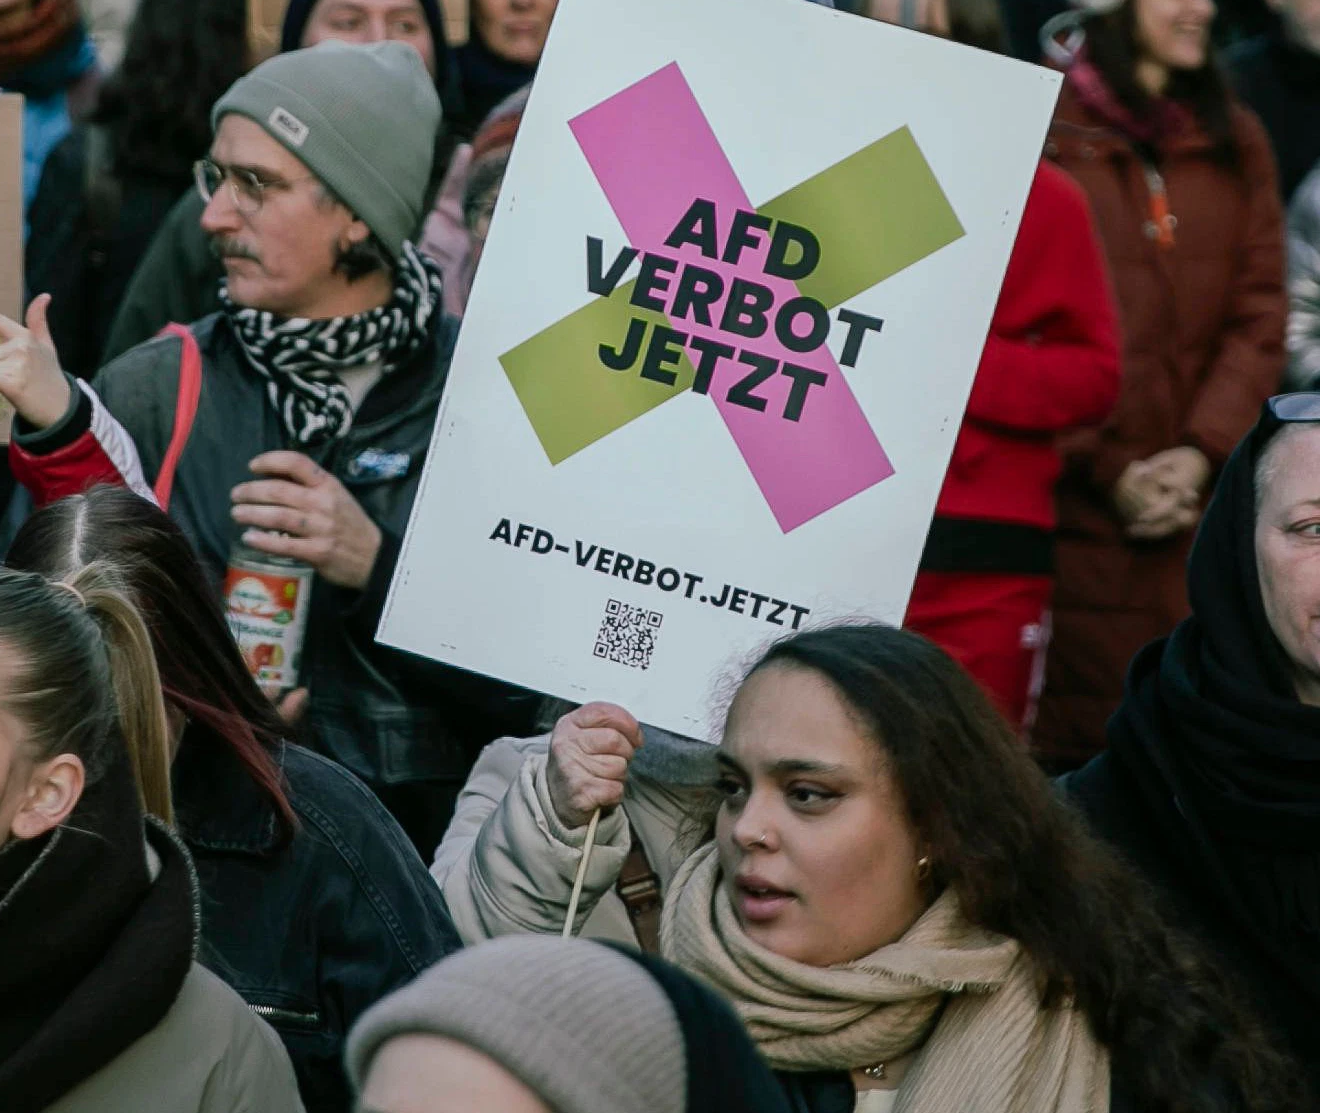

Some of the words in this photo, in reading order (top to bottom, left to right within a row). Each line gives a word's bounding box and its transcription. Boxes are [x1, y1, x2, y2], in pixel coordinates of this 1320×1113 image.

[663, 197, 822, 281] AFD
[585, 235, 885, 368] VERBOT
[597, 316, 829, 423] JETZT
[488, 517, 811, 630] AFD-VERBOT.JETZT
